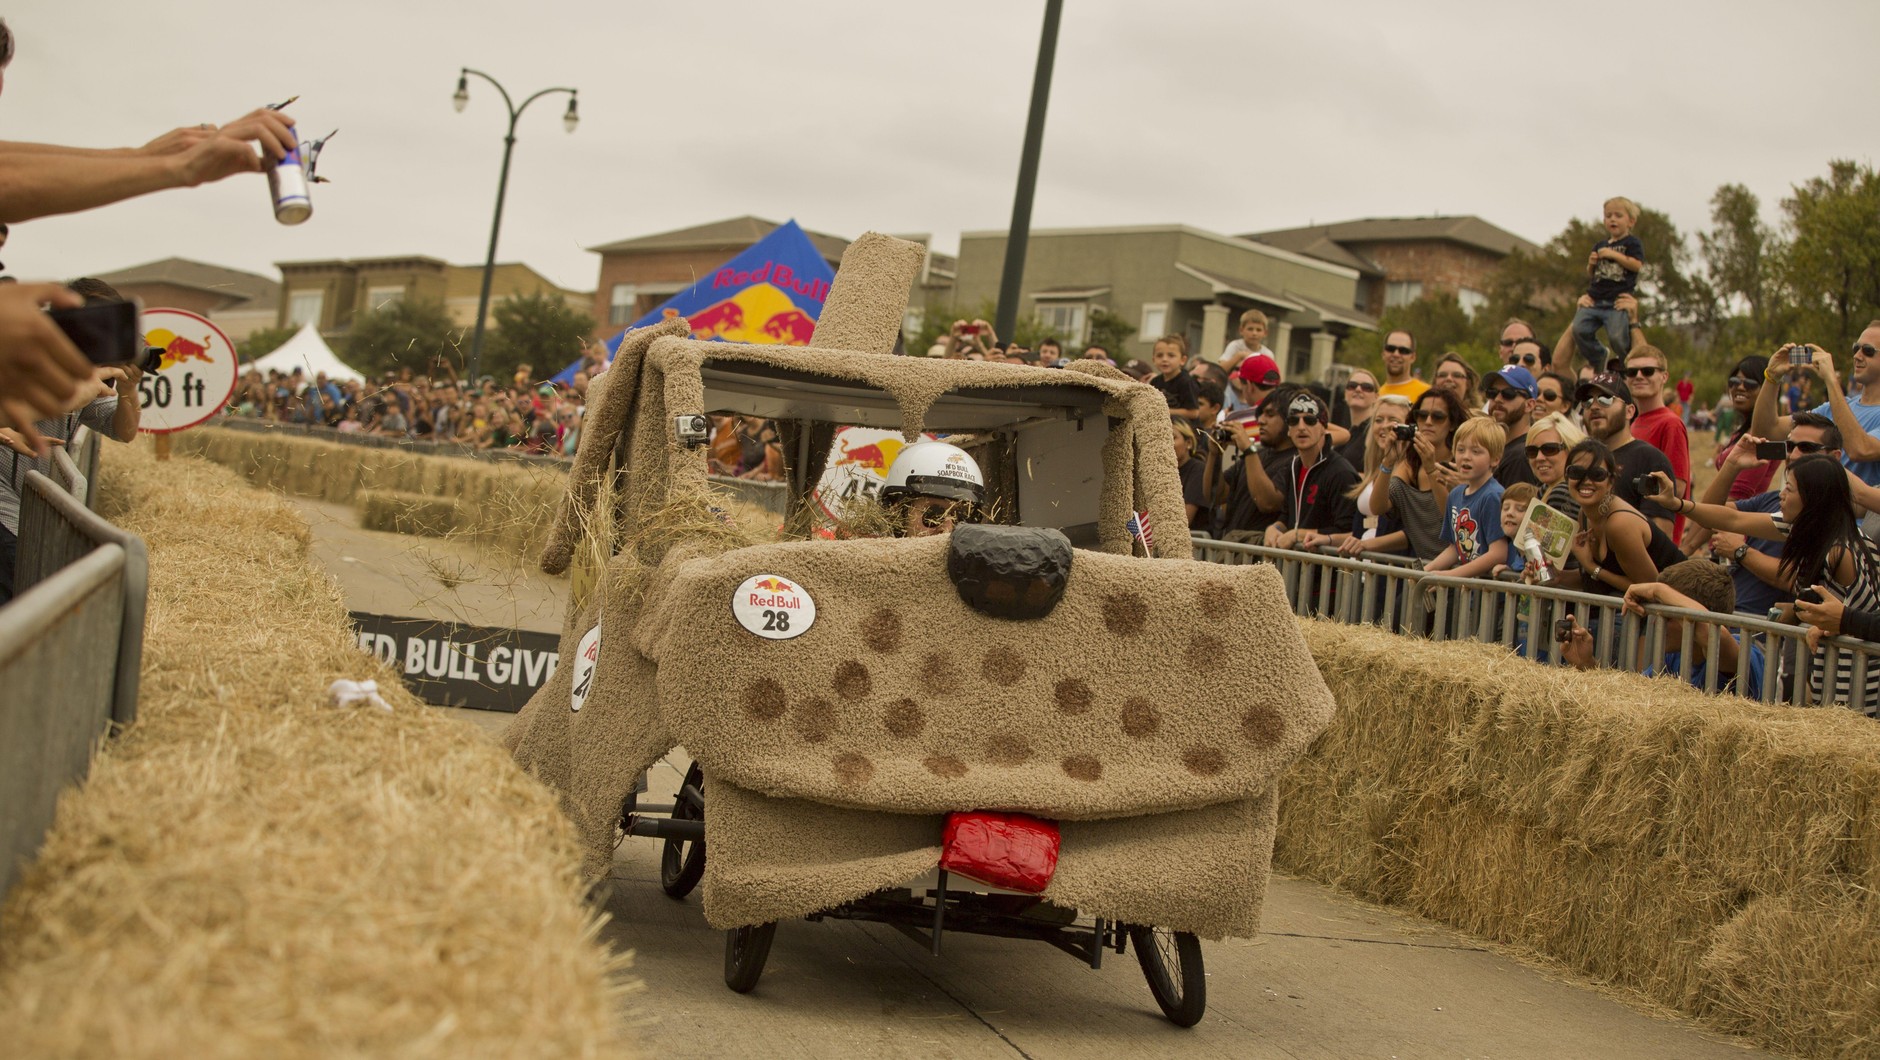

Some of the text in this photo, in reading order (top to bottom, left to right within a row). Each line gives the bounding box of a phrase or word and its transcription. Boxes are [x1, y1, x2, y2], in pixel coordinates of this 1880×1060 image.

[712, 261, 830, 303] Red Bull
[182, 372, 205, 407] ft
[937, 469, 964, 478] SOAPBOX
[749, 593, 800, 609] Red Bull
[762, 609, 790, 632] 28
[405, 636, 480, 681] BULL
